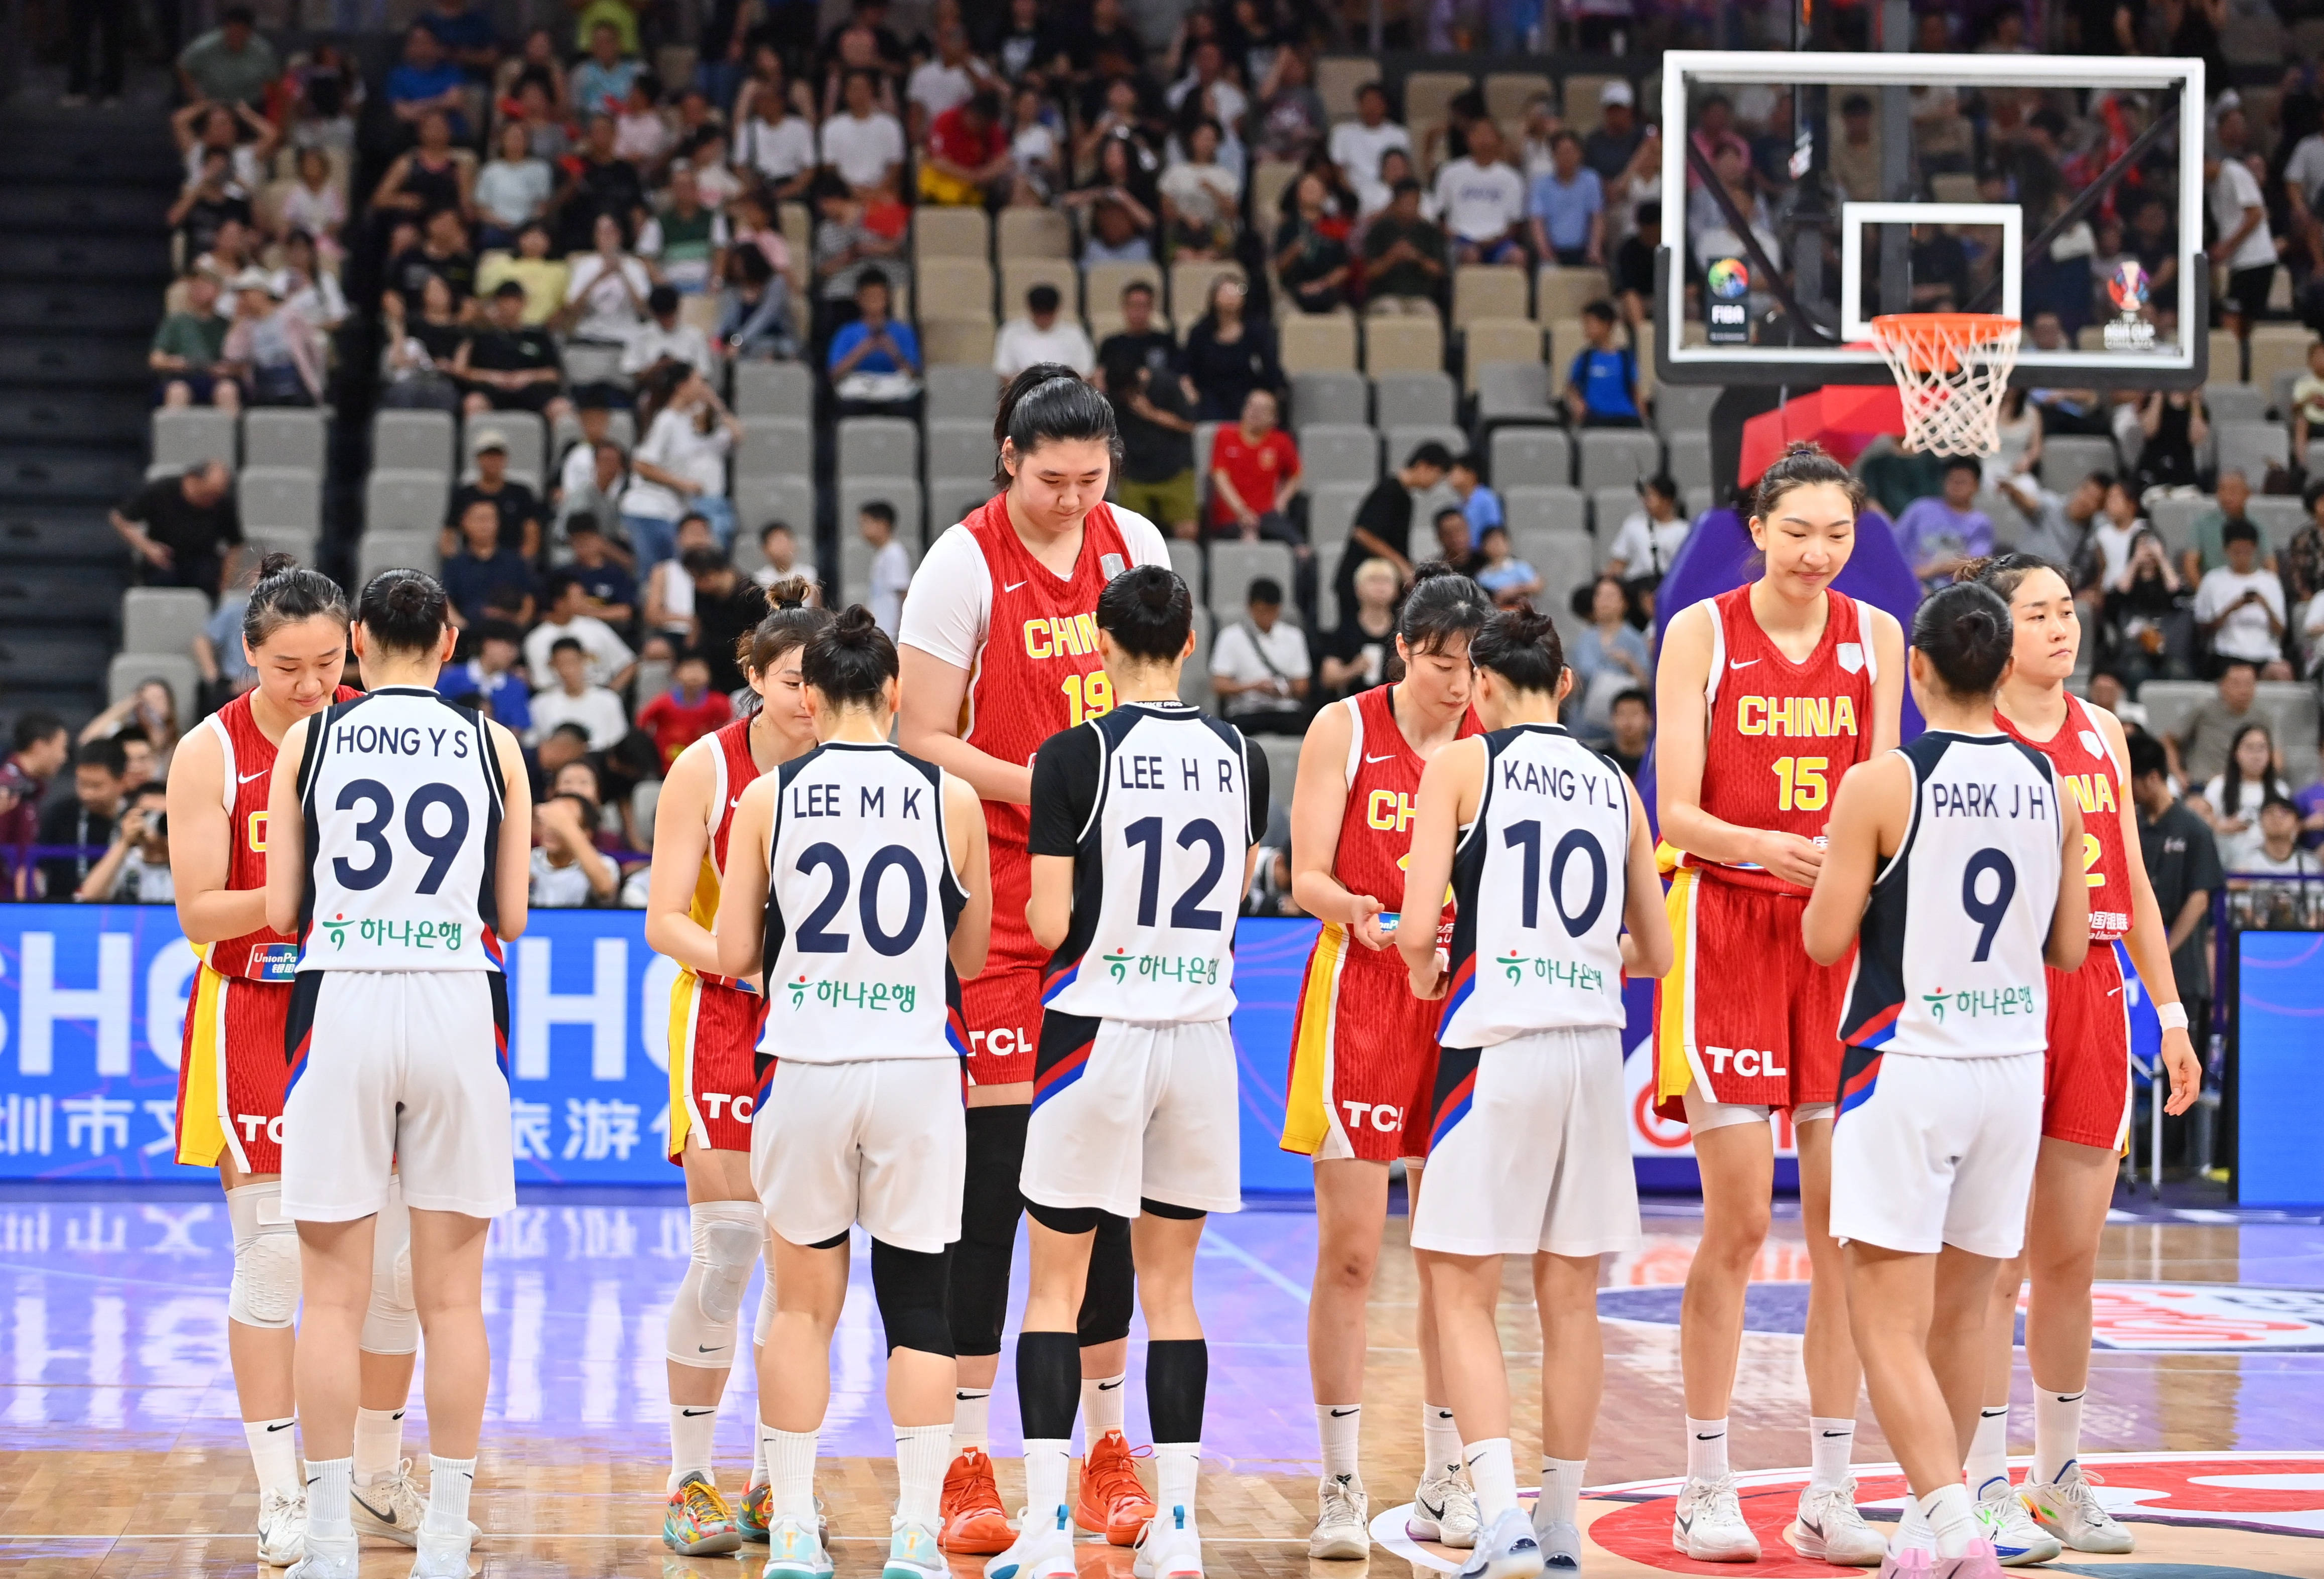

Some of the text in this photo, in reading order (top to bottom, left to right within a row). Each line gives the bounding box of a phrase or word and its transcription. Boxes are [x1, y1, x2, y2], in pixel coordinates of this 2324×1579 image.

[1711, 304, 1746, 325] FIBA
[1024, 611, 1099, 659] CHIN
[1061, 670, 1113, 728] 19
[1737, 696, 1858, 737] CHINA
[336, 725, 468, 758] HONG Y S
[1119, 756, 1233, 793] LEE H R
[1503, 760, 1617, 810] KANG Y L
[1771, 757, 1828, 811] 15
[794, 783, 922, 820] LEE M K
[1933, 783, 1998, 818] PARK
[2010, 784, 2019, 819] J
[2029, 785, 2045, 820] H
[333, 779, 469, 895] 39
[1124, 816, 1225, 932] 12
[1503, 819, 1607, 938] 10
[2084, 833, 2106, 887] 2
[795, 842, 928, 957] 20
[1962, 848, 2016, 962] 9
[360, 918, 462, 951] 하나은행
[253, 952, 297, 963] UnionPa
[1139, 955, 1219, 985] 하나은행
[816, 979, 916, 1013] 하나은행
[1957, 986, 2033, 1017] 하나은행
[967, 1027, 1032, 1057] TCL
[1705, 1045, 1787, 1077] TCL
[702, 1092, 753, 1123] TC
[237, 1114, 283, 1142] TC
